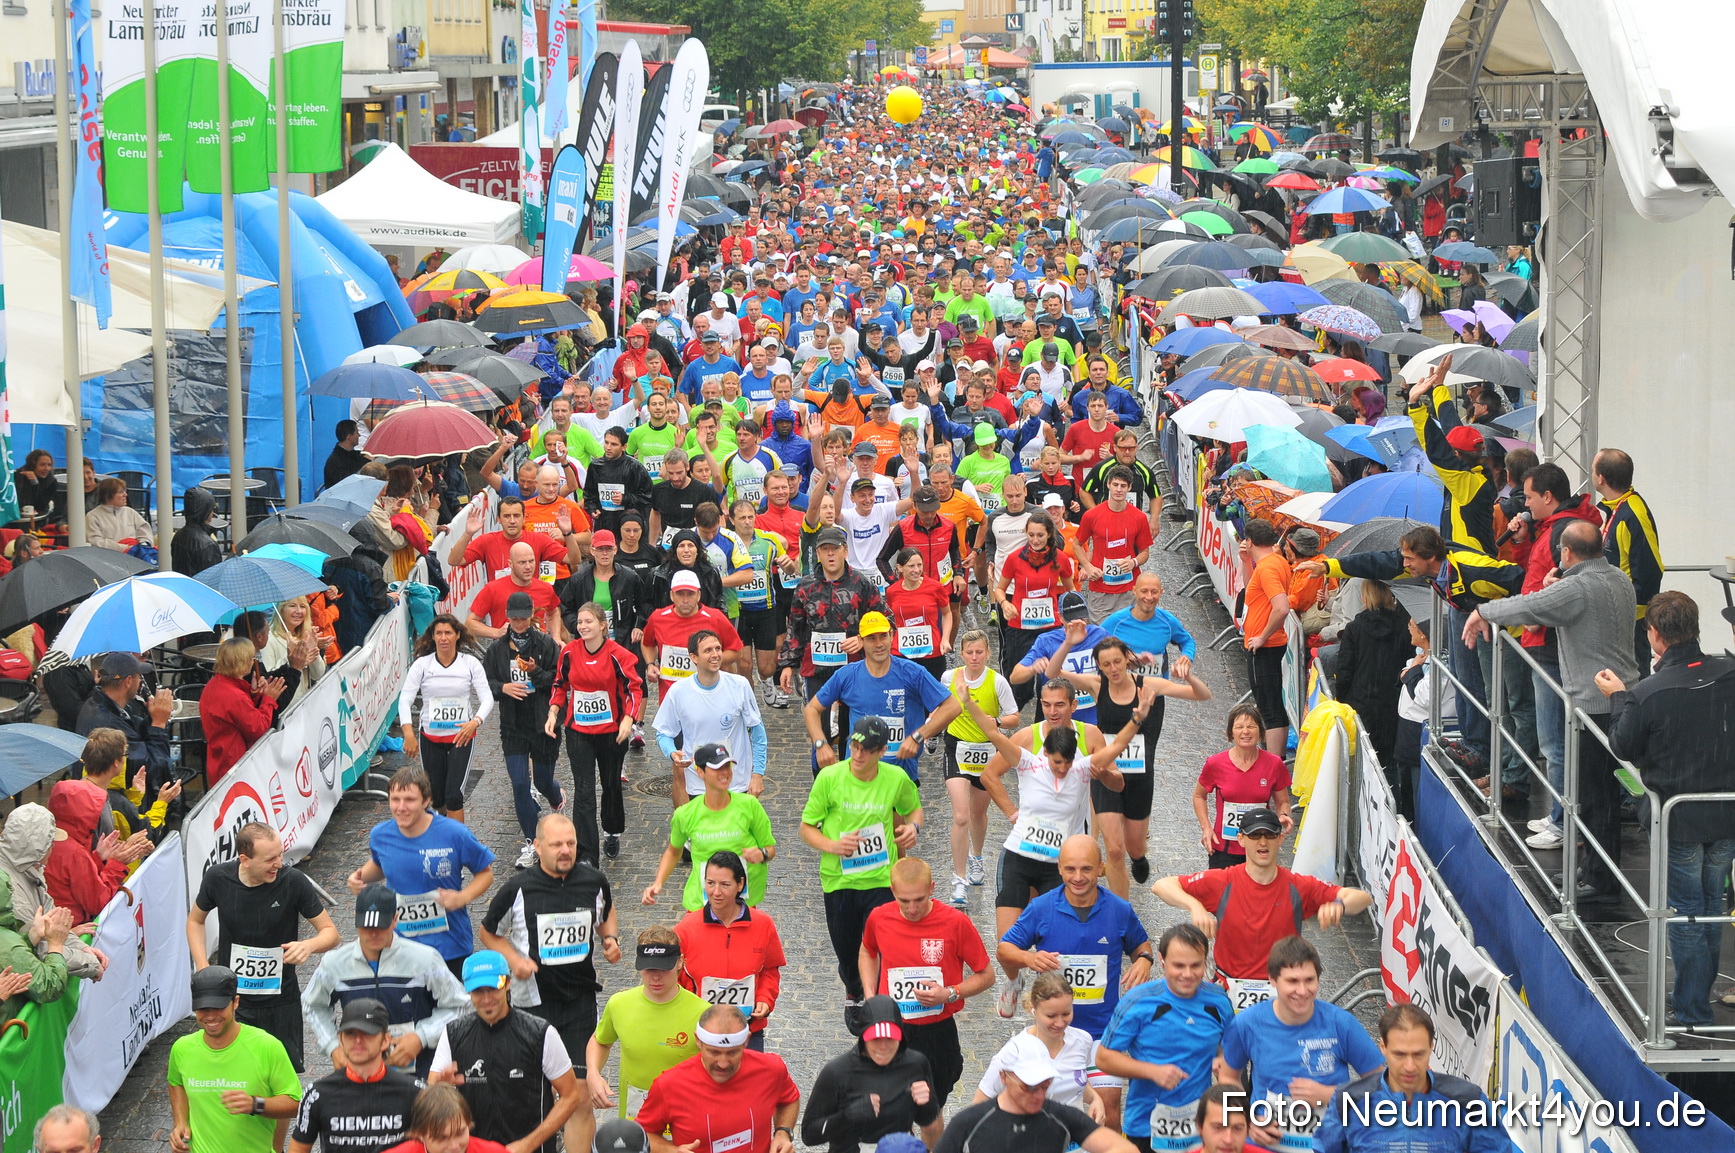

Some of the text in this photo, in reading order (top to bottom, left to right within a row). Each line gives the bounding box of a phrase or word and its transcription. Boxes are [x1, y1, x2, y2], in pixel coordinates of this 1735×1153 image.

[1007, 15, 1021, 28] KL
[675, 126, 687, 168] BKK
[667, 171, 680, 218] Audi
[370, 227, 467, 238] www.audibkk.de
[884, 372, 903, 381] 2696
[742, 490, 760, 501] 450
[1025, 606, 1051, 619] 2376
[902, 633, 929, 647] 2365
[669, 655, 691, 670] 393
[433, 707, 464, 721] 2697
[577, 699, 607, 714] 2698
[963, 751, 989, 764] 289
[283, 826, 298, 854] EAT
[1025, 826, 1063, 847] 2998
[399, 901, 439, 921] 2531
[544, 925, 587, 946] 2789
[235, 959, 277, 978] 2532
[707, 987, 749, 1005] 2227
[330, 1115, 403, 1131] SIEMENS
[723, 1137, 741, 1148] DEHN
